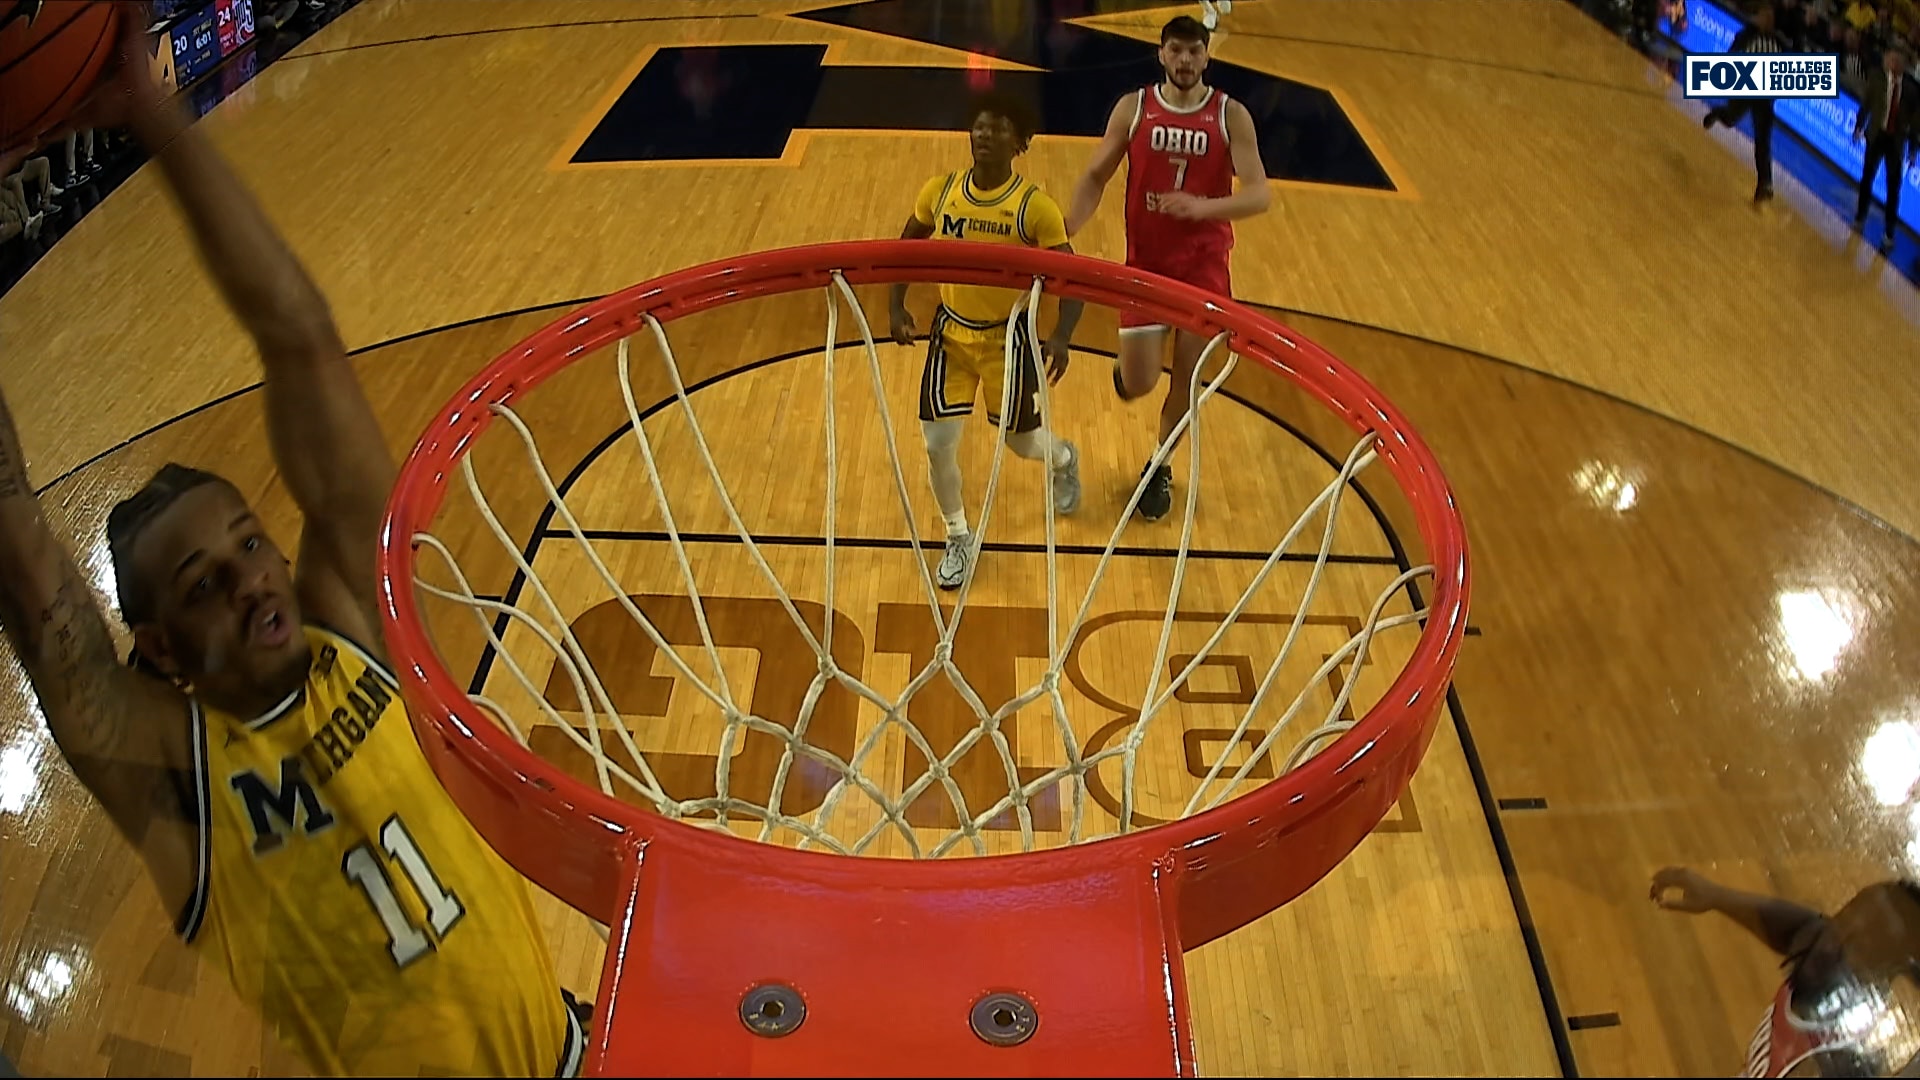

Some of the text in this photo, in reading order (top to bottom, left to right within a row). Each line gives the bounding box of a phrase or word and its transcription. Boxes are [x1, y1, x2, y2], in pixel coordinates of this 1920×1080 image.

[217, 6, 231, 27] 24
[174, 35, 188, 56] 20
[1150, 125, 1208, 155] OHIO
[1168, 157, 1188, 190] 7
[942, 213, 1012, 238] MICHIGAN
[341, 812, 466, 968] 11
